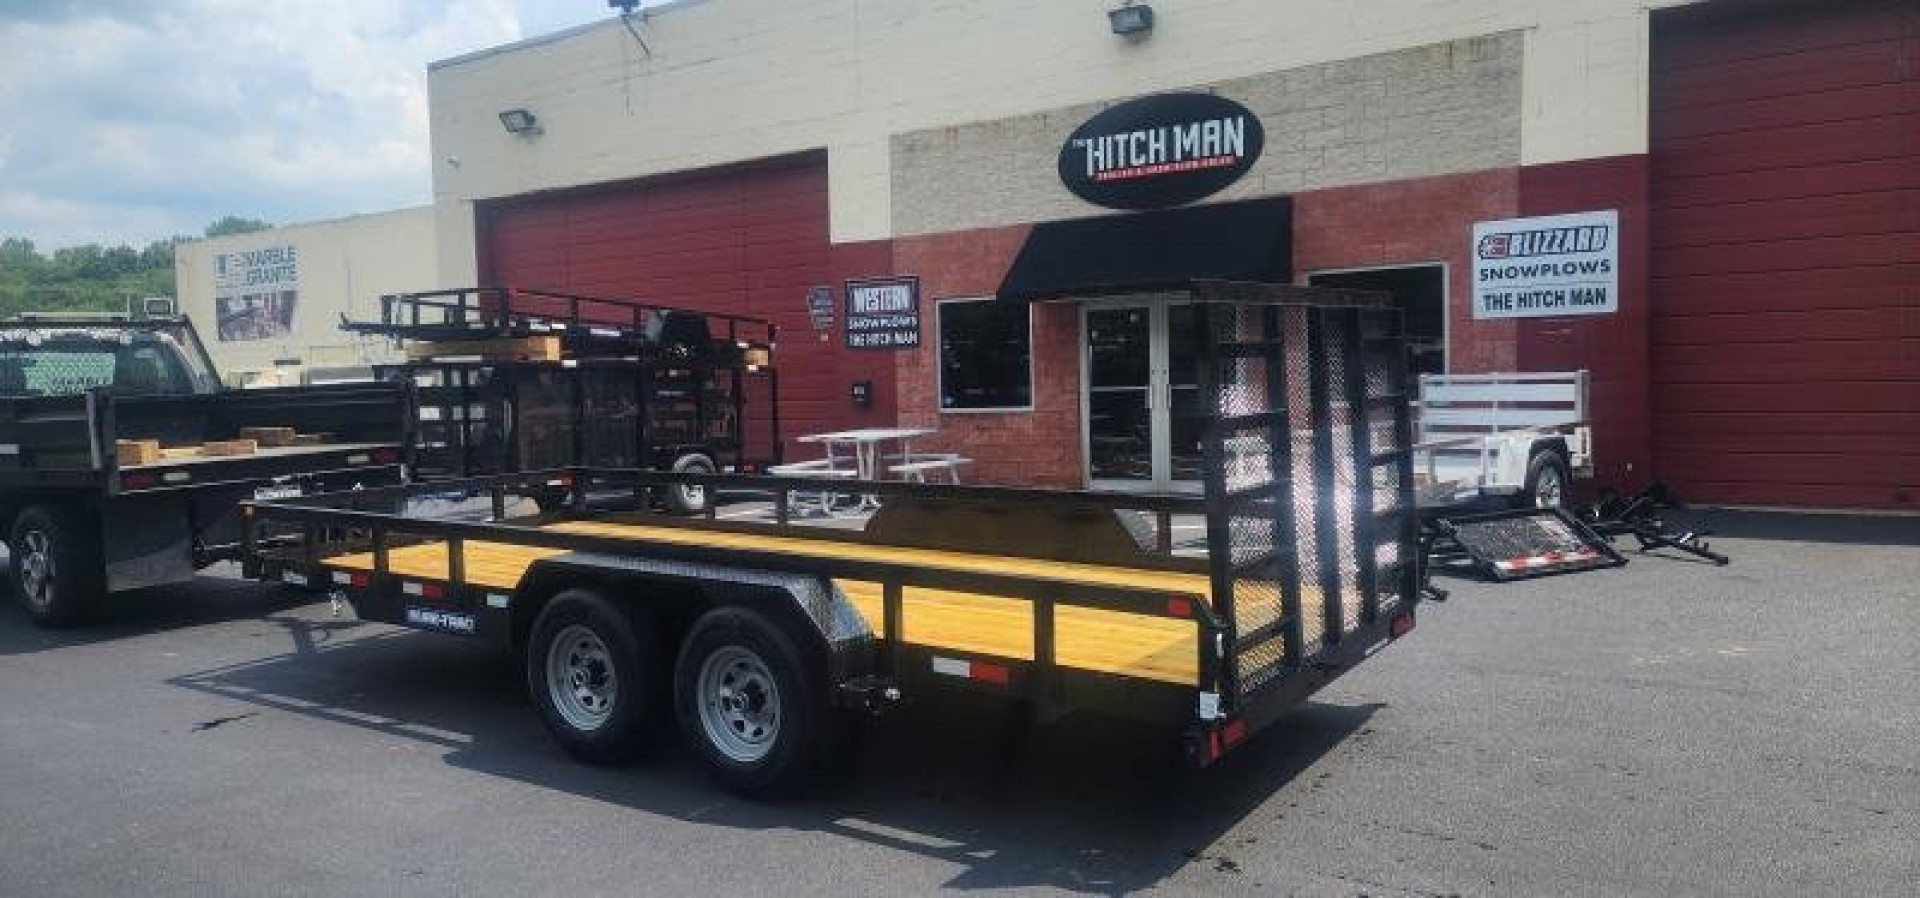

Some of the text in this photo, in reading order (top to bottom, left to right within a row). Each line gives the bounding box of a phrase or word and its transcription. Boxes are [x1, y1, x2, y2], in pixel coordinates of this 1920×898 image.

[1086, 127, 1165, 177] HITCH
[1173, 115, 1244, 161] MAN
[1507, 226, 1609, 258] BLIZZARD
[247, 246, 296, 267] MARBLE
[246, 266, 296, 286] GRANITE
[1479, 259, 1611, 282] SNOWPLOWS
[853, 286, 910, 313] WESTERN
[1482, 287, 1607, 312] THE HITCH MAN
[848, 315, 918, 330] SNOWPLOWS
